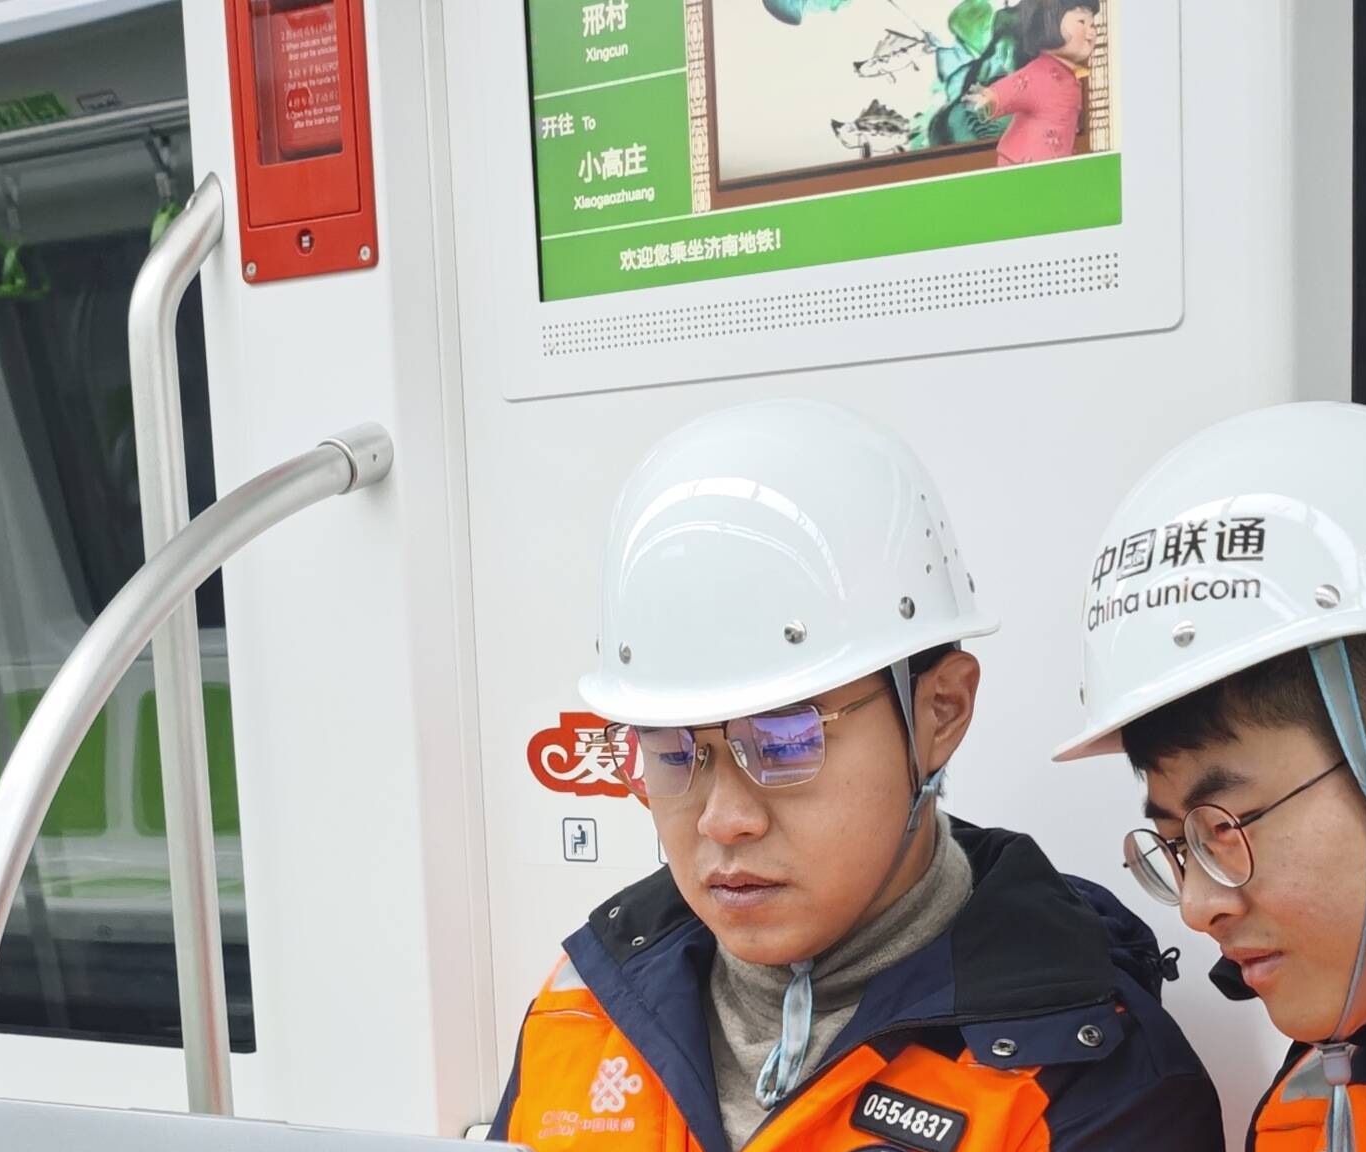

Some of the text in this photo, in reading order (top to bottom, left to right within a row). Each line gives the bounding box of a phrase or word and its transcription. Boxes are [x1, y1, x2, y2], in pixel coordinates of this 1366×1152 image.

[582, 0, 628, 37] 邢村
[586, 44, 628, 62] Xingcun
[542, 113, 574, 139] 开往
[582, 116, 596, 132] To
[578, 143, 648, 183] 小高庄
[574, 187, 655, 210] Xiaogaozhuang
[1091, 517, 1265, 591] 中国联通
[1146, 576, 1261, 608] unicom
[863, 1094, 953, 1142] 0554837
